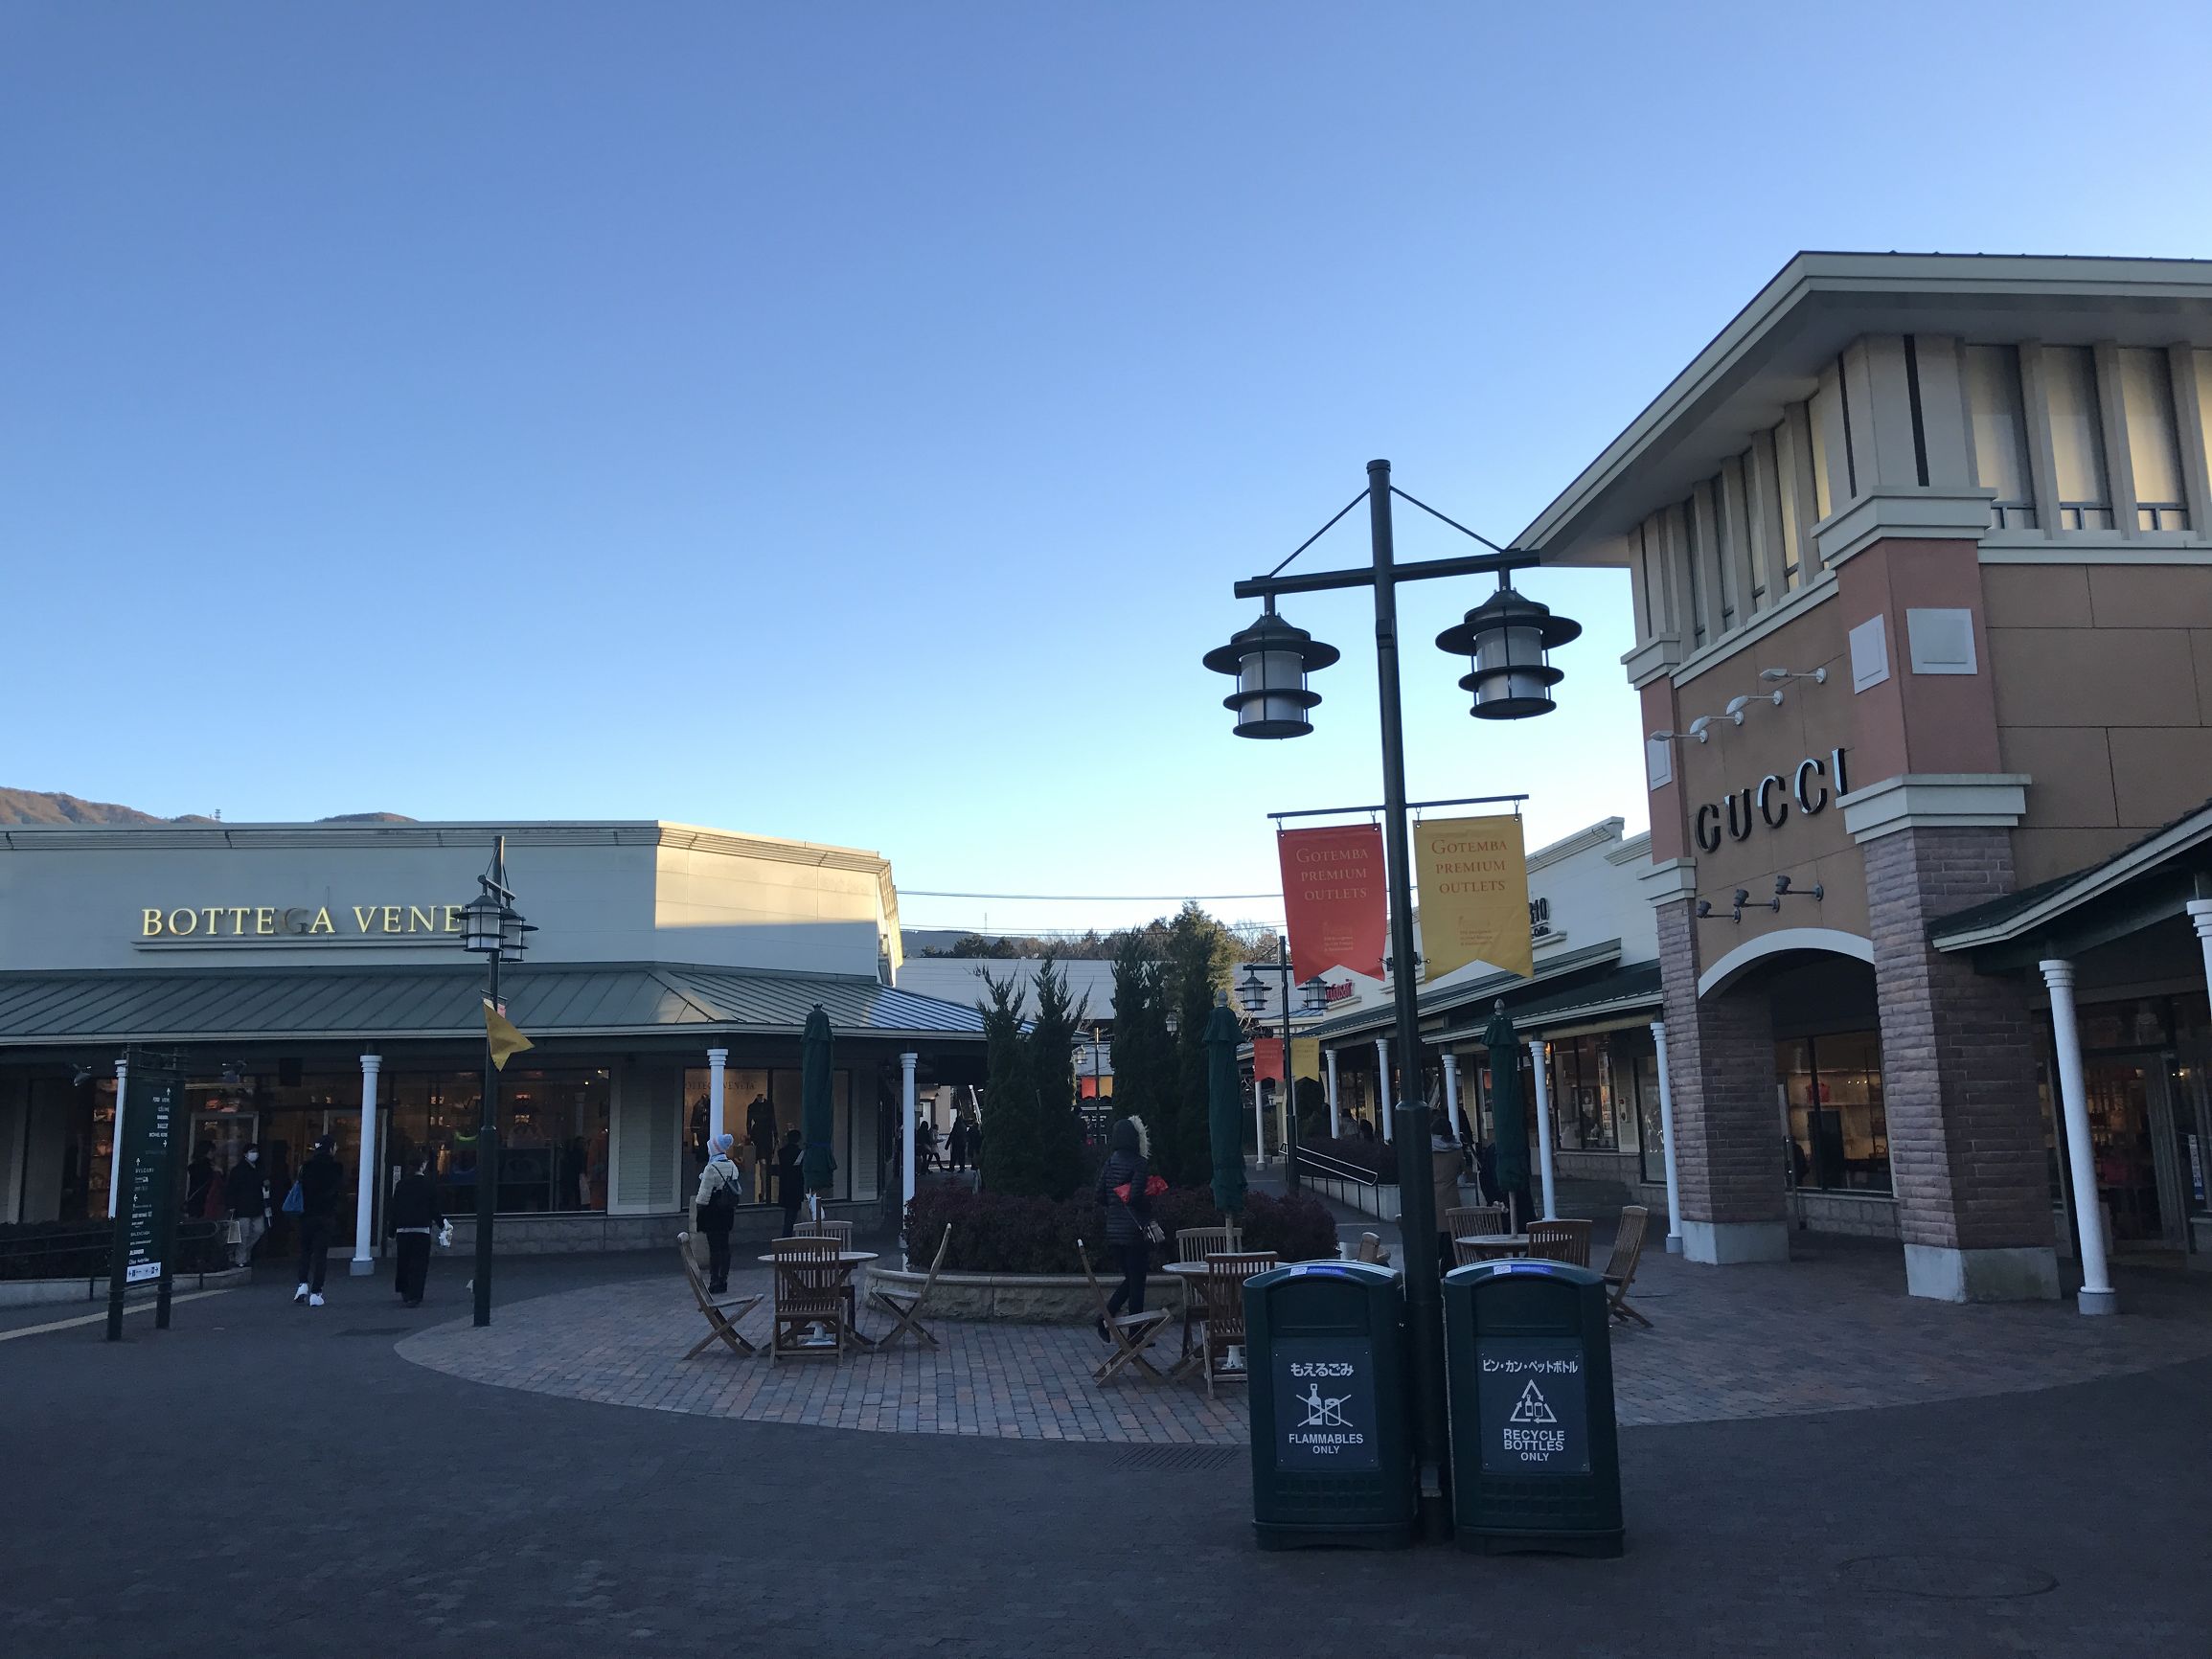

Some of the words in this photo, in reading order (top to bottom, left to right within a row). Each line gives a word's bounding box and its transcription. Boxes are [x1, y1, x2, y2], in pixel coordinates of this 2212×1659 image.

[1695, 748, 1848, 853] GUCCI
[1431, 839, 1508, 855] GOTEMBA
[1295, 848, 1369, 864] GOTEMBA
[1436, 860, 1506, 875] PREMIUM
[1301, 868, 1367, 882] PREMIUM
[1304, 887, 1367, 901] OUTLETS
[1439, 880, 1506, 894] OUTLETS
[141, 906, 335, 936] BOTTEGA
[353, 905, 465, 934] VENE
[1290, 1362, 1355, 1377] もえるごみ
[1288, 1433, 1364, 1444] FLAMMABLES
[1503, 1428, 1565, 1441] RECYCLE
[1311, 1444, 1340, 1454] ONLY
[1503, 1440, 1564, 1452] BOTTLES
[1520, 1451, 1550, 1462] ONLY
